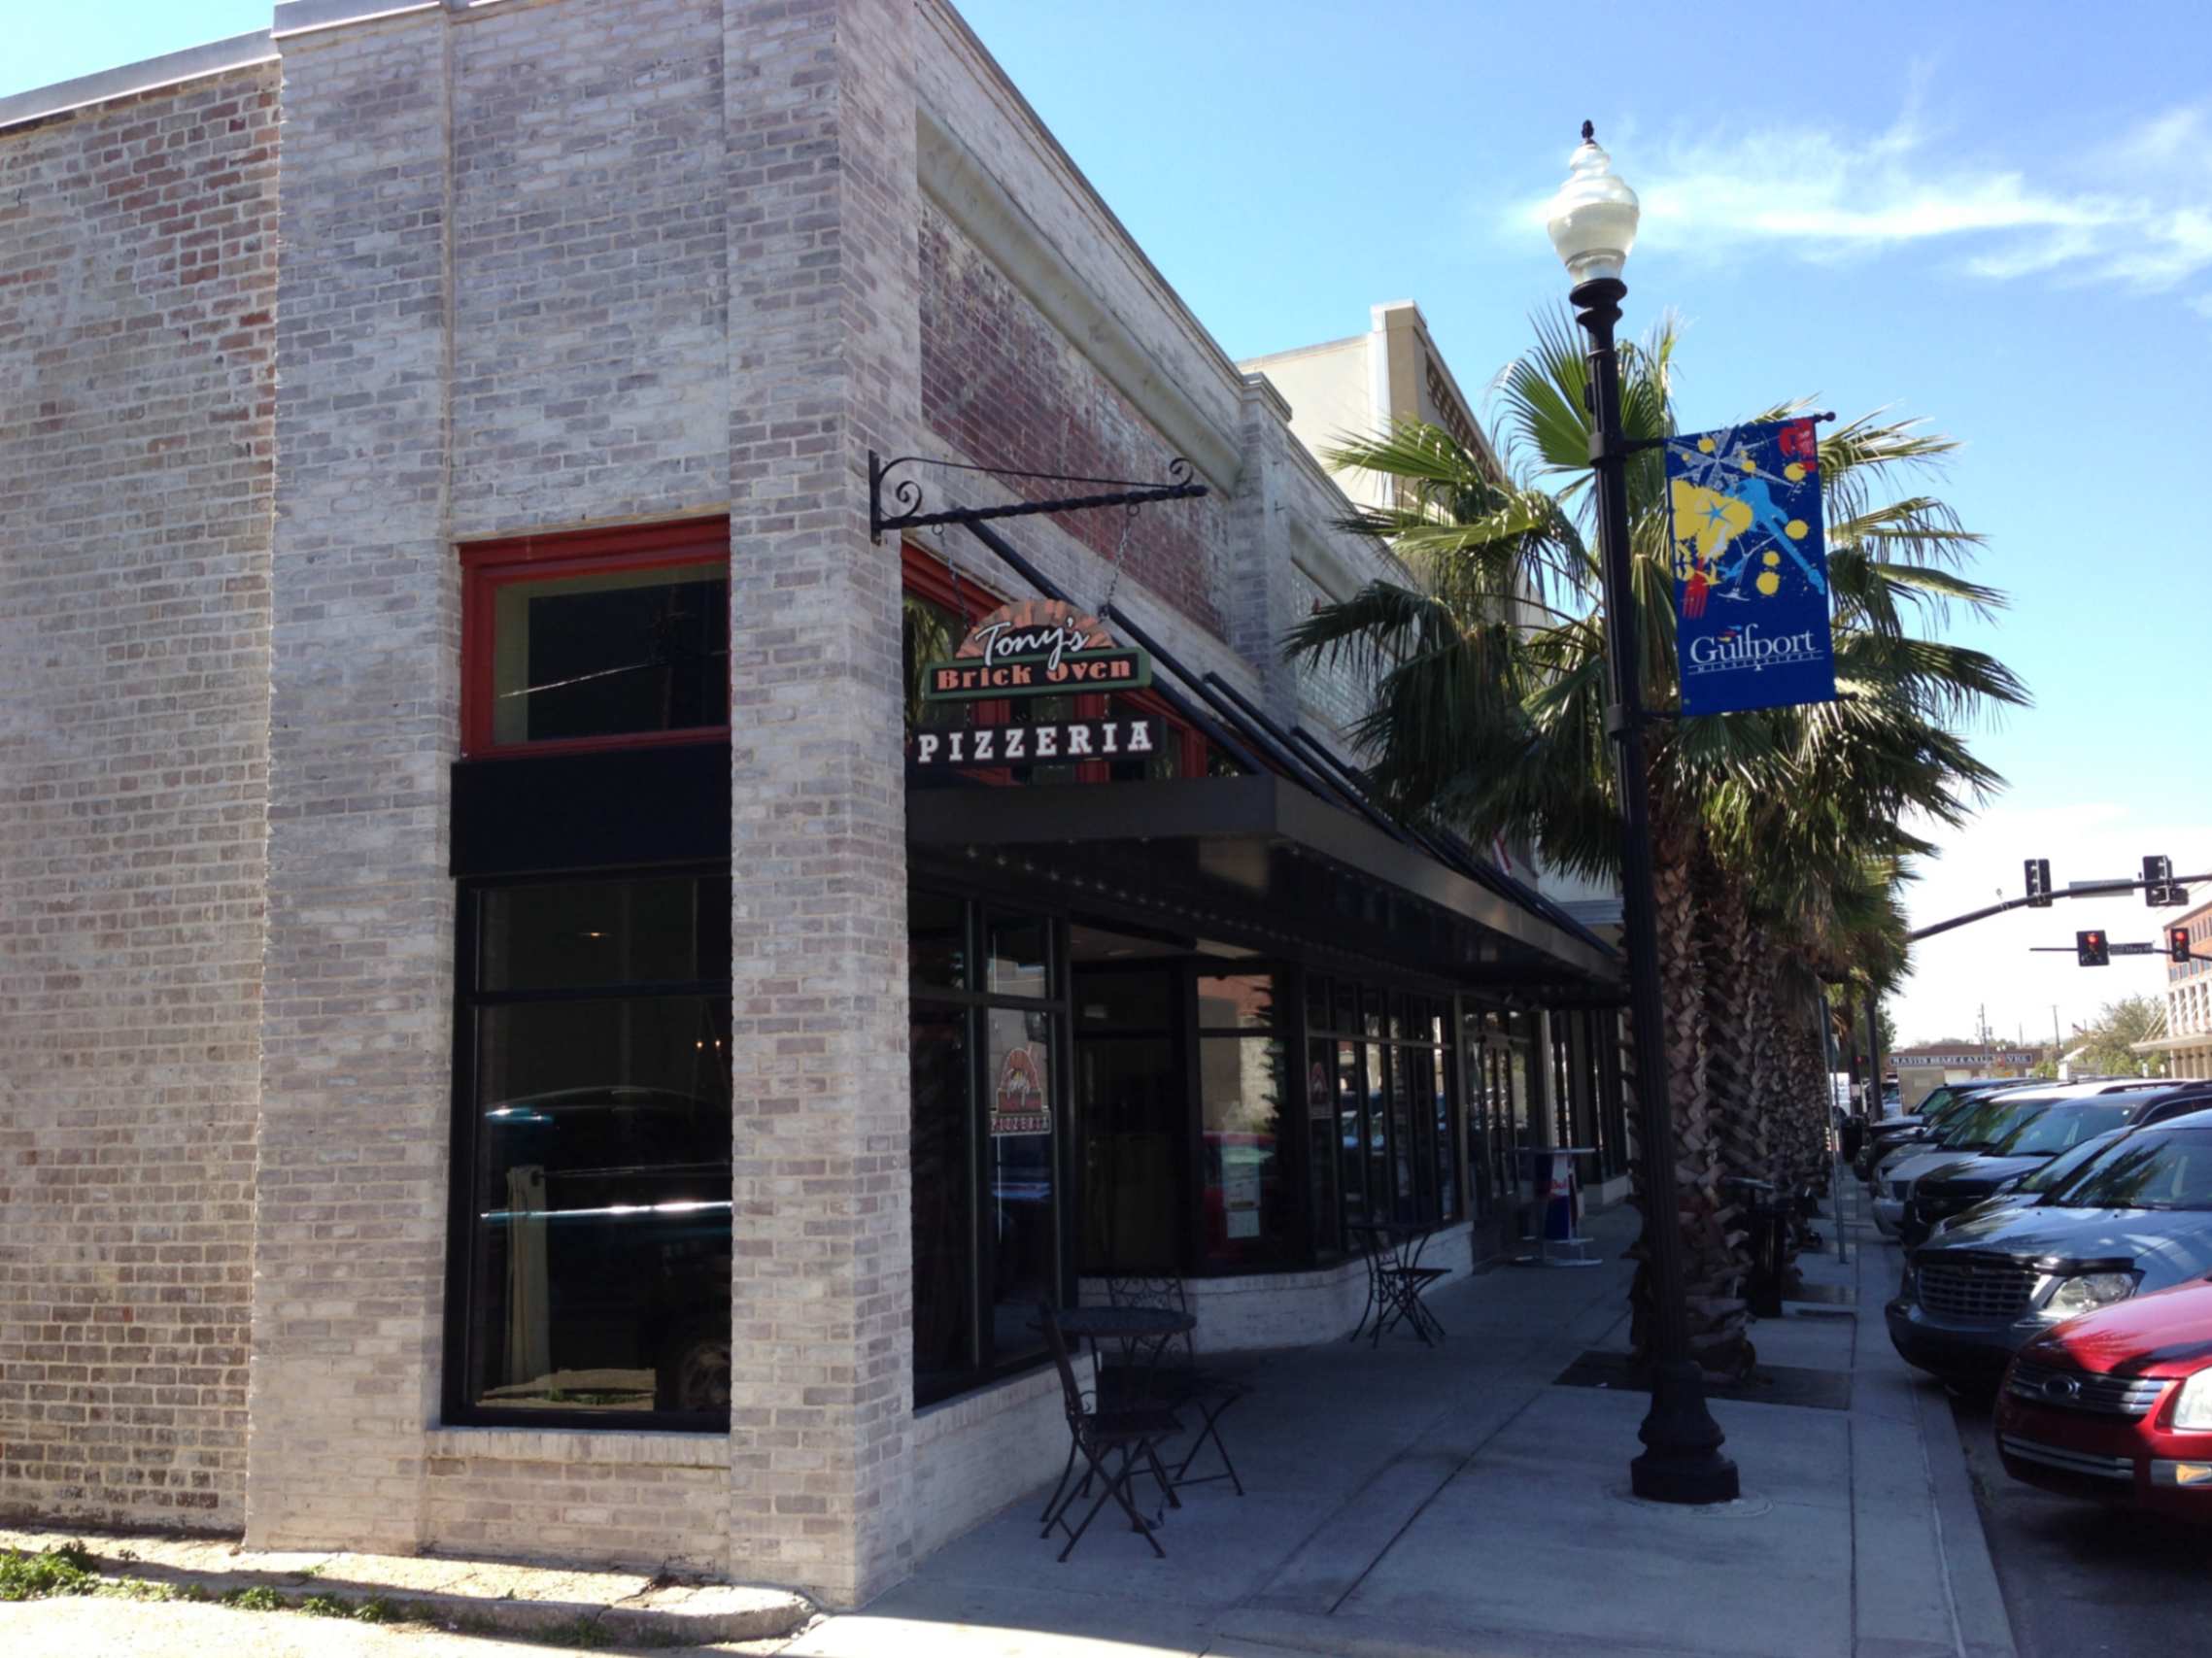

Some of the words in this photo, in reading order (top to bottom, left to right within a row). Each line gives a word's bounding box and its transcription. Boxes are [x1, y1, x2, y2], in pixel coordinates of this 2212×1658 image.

[975, 618, 1089, 670] Tony's
[1689, 623, 1816, 671] Gulfport
[937, 664, 1032, 691] Brick
[1046, 660, 1131, 682] Oven
[918, 721, 1152, 762] PIZZERIA
